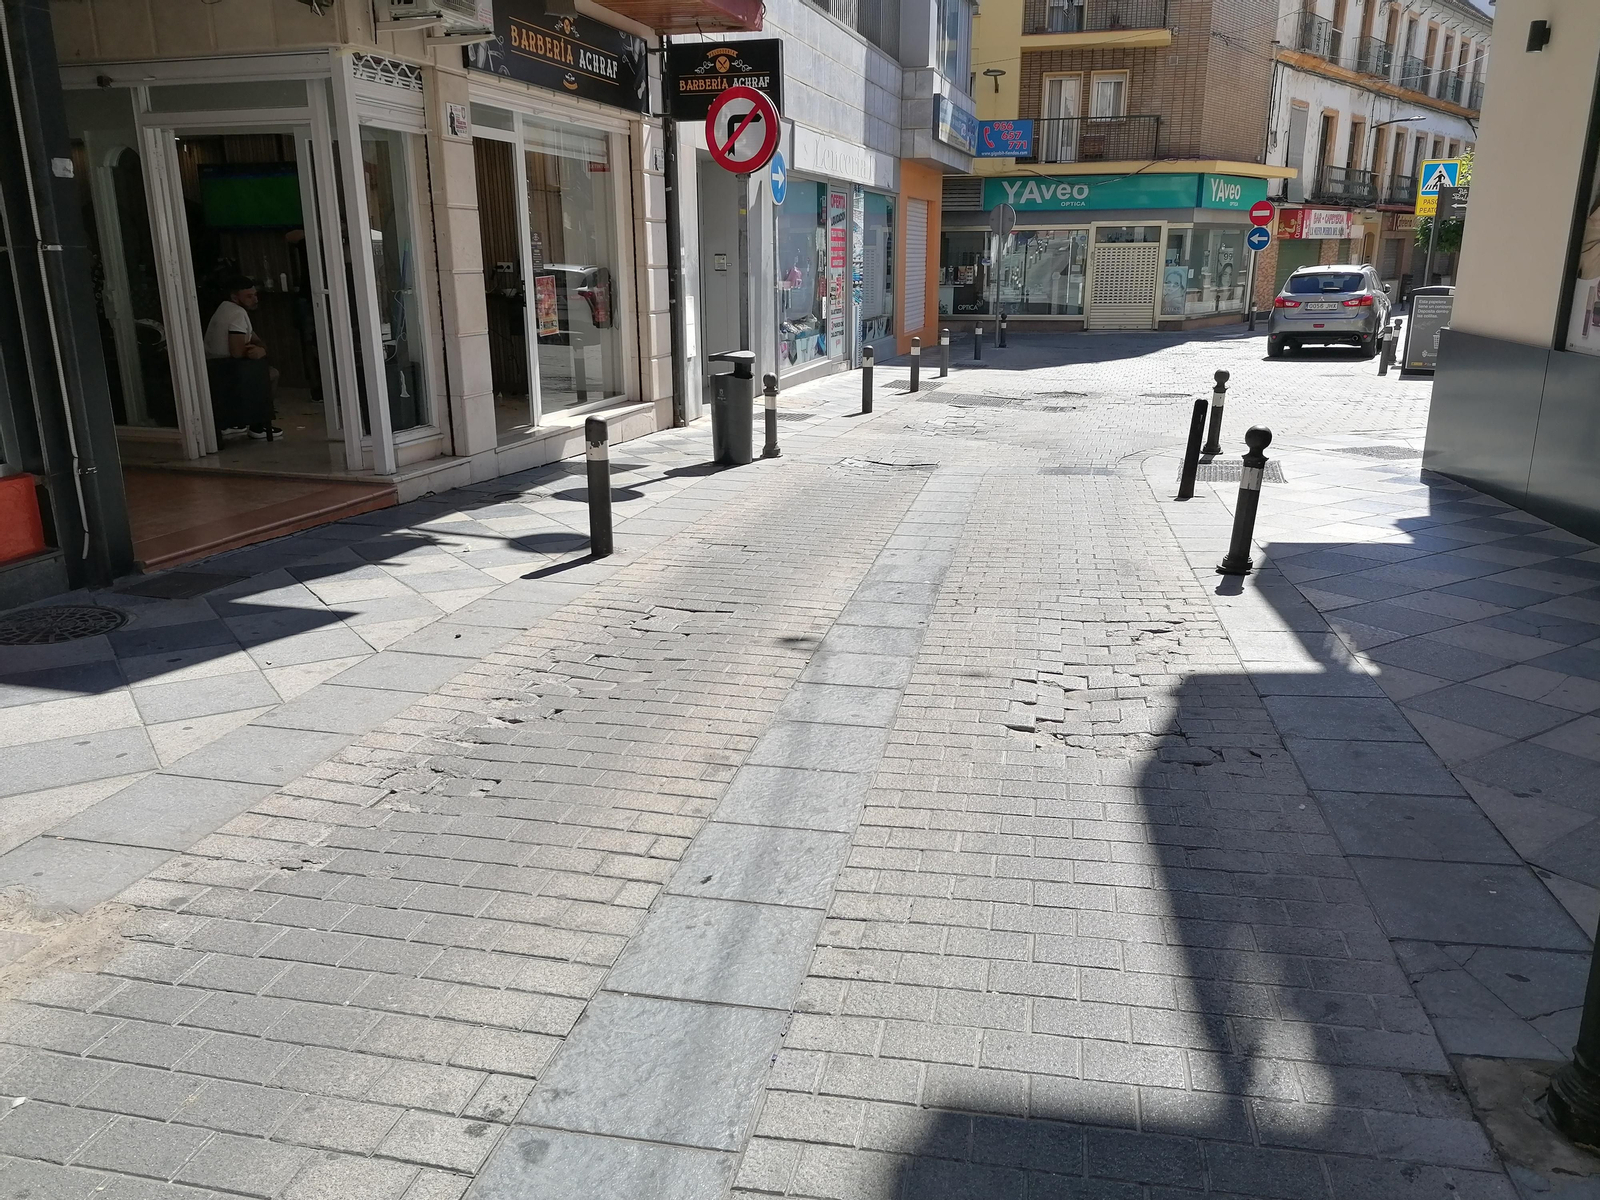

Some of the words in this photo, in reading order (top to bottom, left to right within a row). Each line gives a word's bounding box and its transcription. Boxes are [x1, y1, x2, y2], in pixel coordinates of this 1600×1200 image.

[510, 25, 574, 65] BARBERÍA
[579, 48, 618, 79] ACHRAF
[680, 76, 728, 91] BARBERÍA
[733, 77, 769, 88] ACHRAF
[993, 121, 1014, 131] 956
[1001, 130, 1022, 140] 657
[1008, 141, 1027, 150] 771
[1001, 180, 1089, 204] YAveo
[1211, 178, 1241, 202] YAveo
[1313, 212, 1322, 225] BAR
